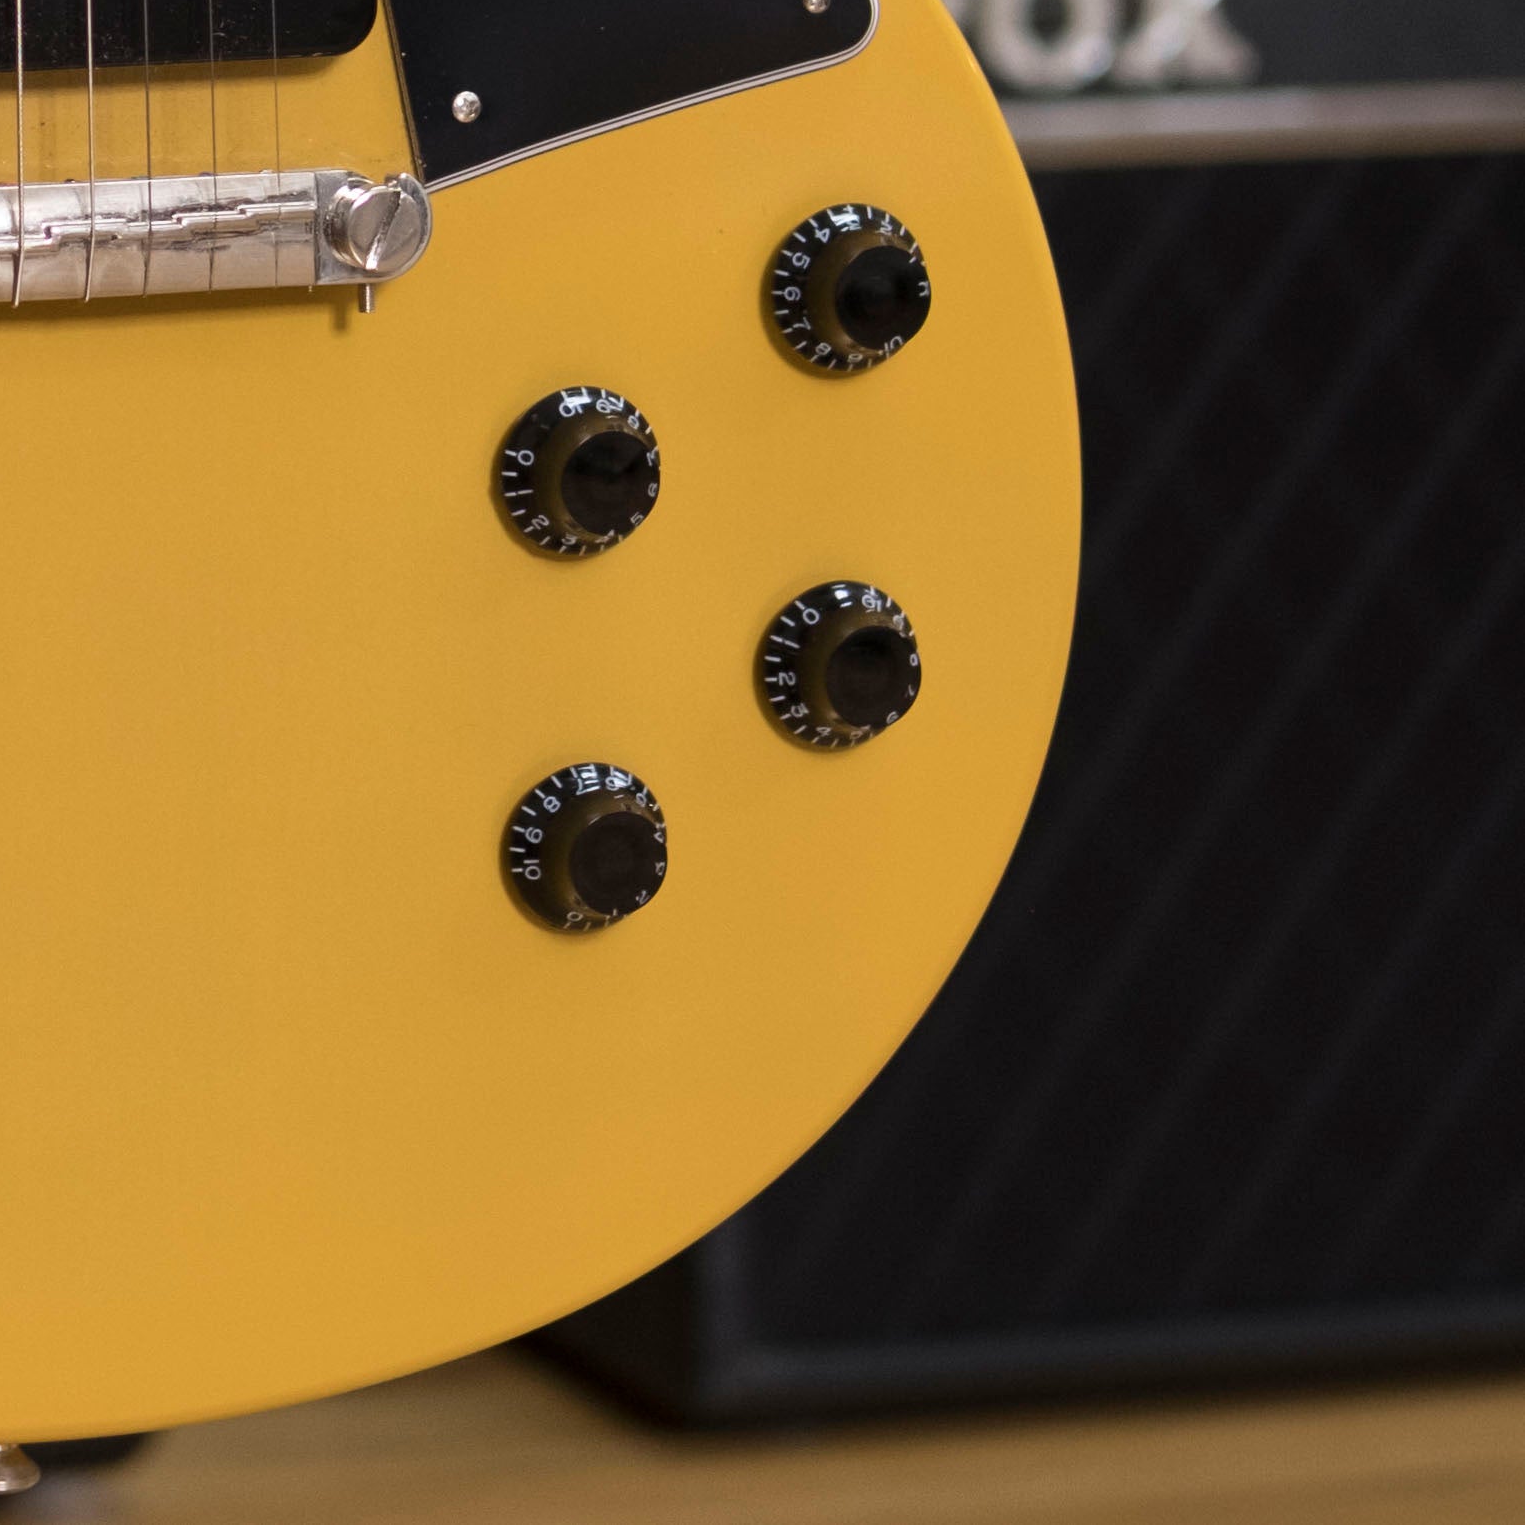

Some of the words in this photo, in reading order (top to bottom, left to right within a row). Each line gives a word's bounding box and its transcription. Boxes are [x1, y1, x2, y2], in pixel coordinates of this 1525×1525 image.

[814, 227, 830, 244] 4
[792, 251, 811, 269] 5
[784, 286, 801, 301] 6
[792, 316, 812, 331] 7
[517, 449, 535, 466] 0
[531, 514, 550, 530] 2
[802, 607, 820, 625] 0
[778, 672, 796, 686] 2
[790, 702, 810, 718] 3
[543, 795, 561, 813] 8
[525, 827, 543, 844] 9
[523, 859, 542, 881] 10
